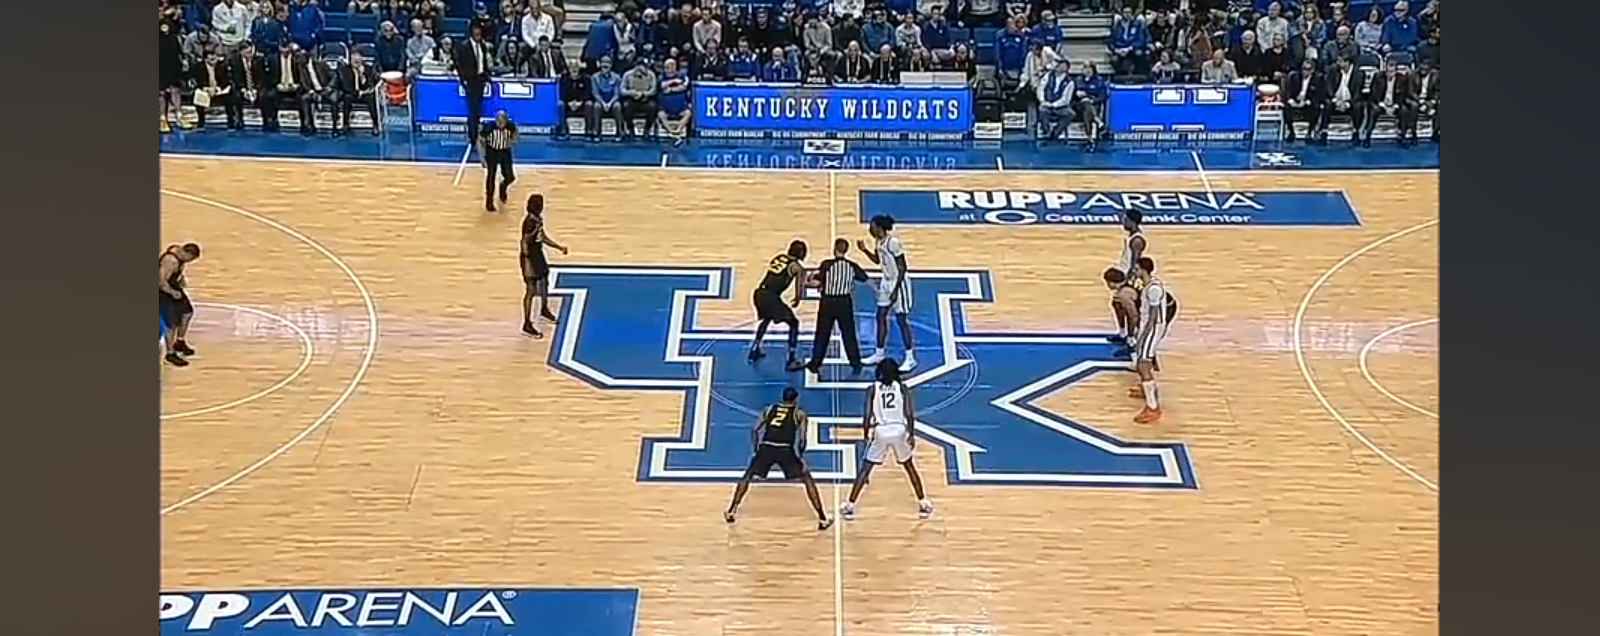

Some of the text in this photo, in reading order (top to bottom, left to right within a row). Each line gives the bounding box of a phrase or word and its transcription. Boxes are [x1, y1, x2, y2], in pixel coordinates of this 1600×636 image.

[705, 96, 960, 120] KENTUCKY WILDCATS
[938, 190, 1264, 210] RUPP ARENA
[959, 212, 1251, 223] at Central ank Center
[881, 392, 897, 409] 12
[770, 411, 787, 427] 2
